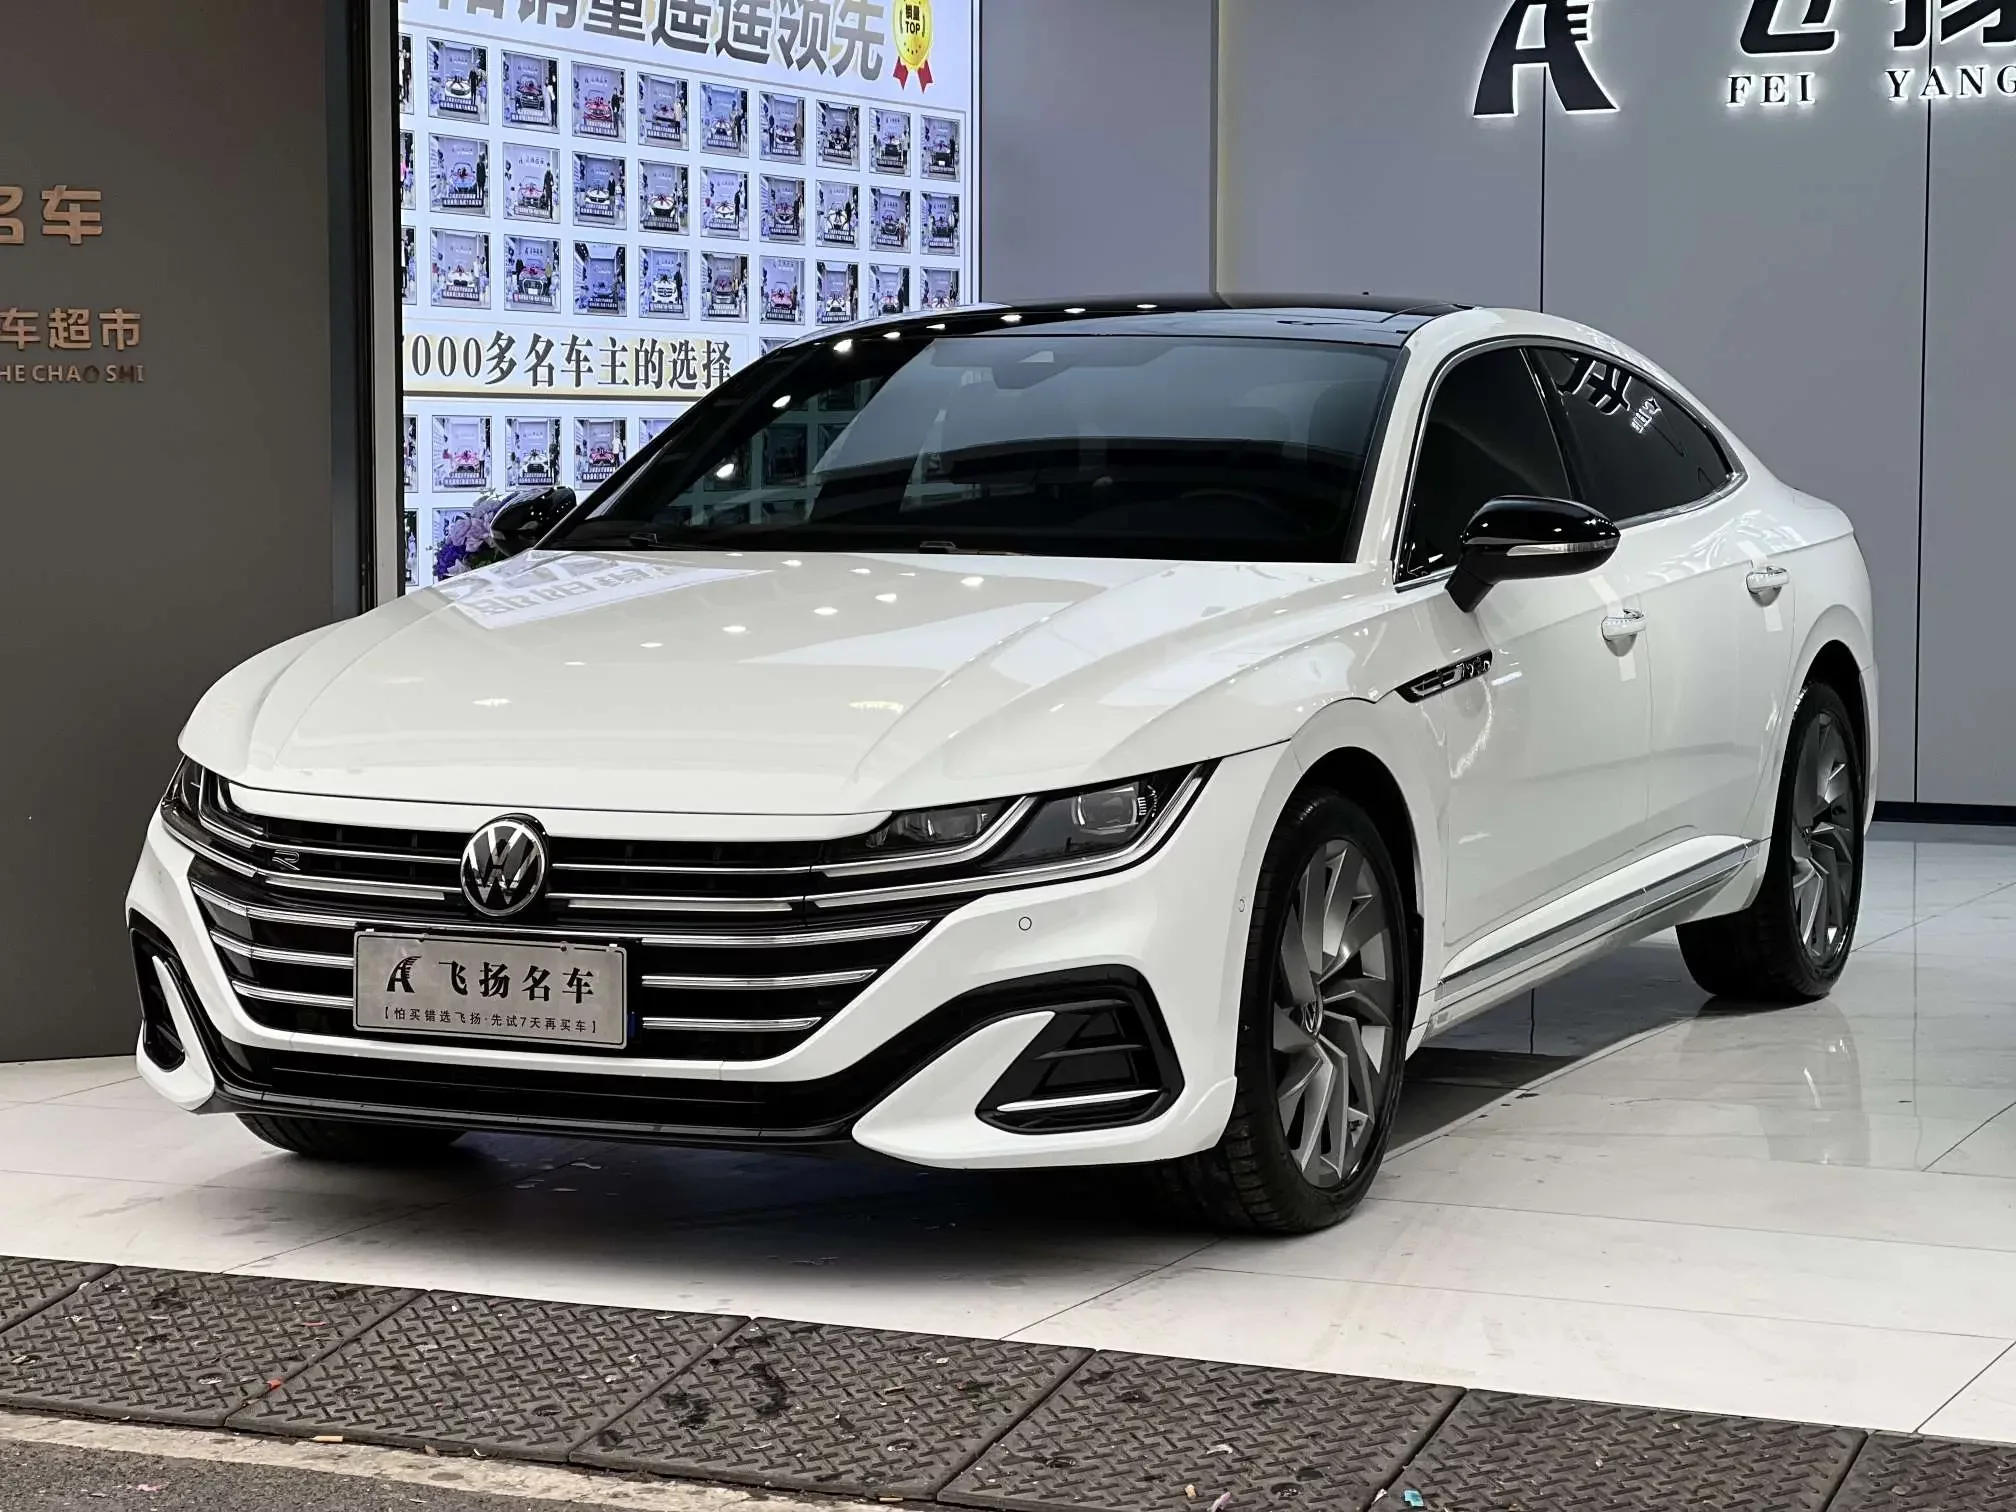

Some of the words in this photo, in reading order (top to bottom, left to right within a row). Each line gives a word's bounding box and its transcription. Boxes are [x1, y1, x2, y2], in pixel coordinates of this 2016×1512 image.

[905, 21, 921, 34] TOP
[1728, 74, 1815, 104] FEI
[1885, 66, 2016, 98] YANG
[0, 307, 141, 350] 车超市
[402, 330, 732, 390] 000多名车主的选择
[438, 959, 595, 1004] 飞扬名车
